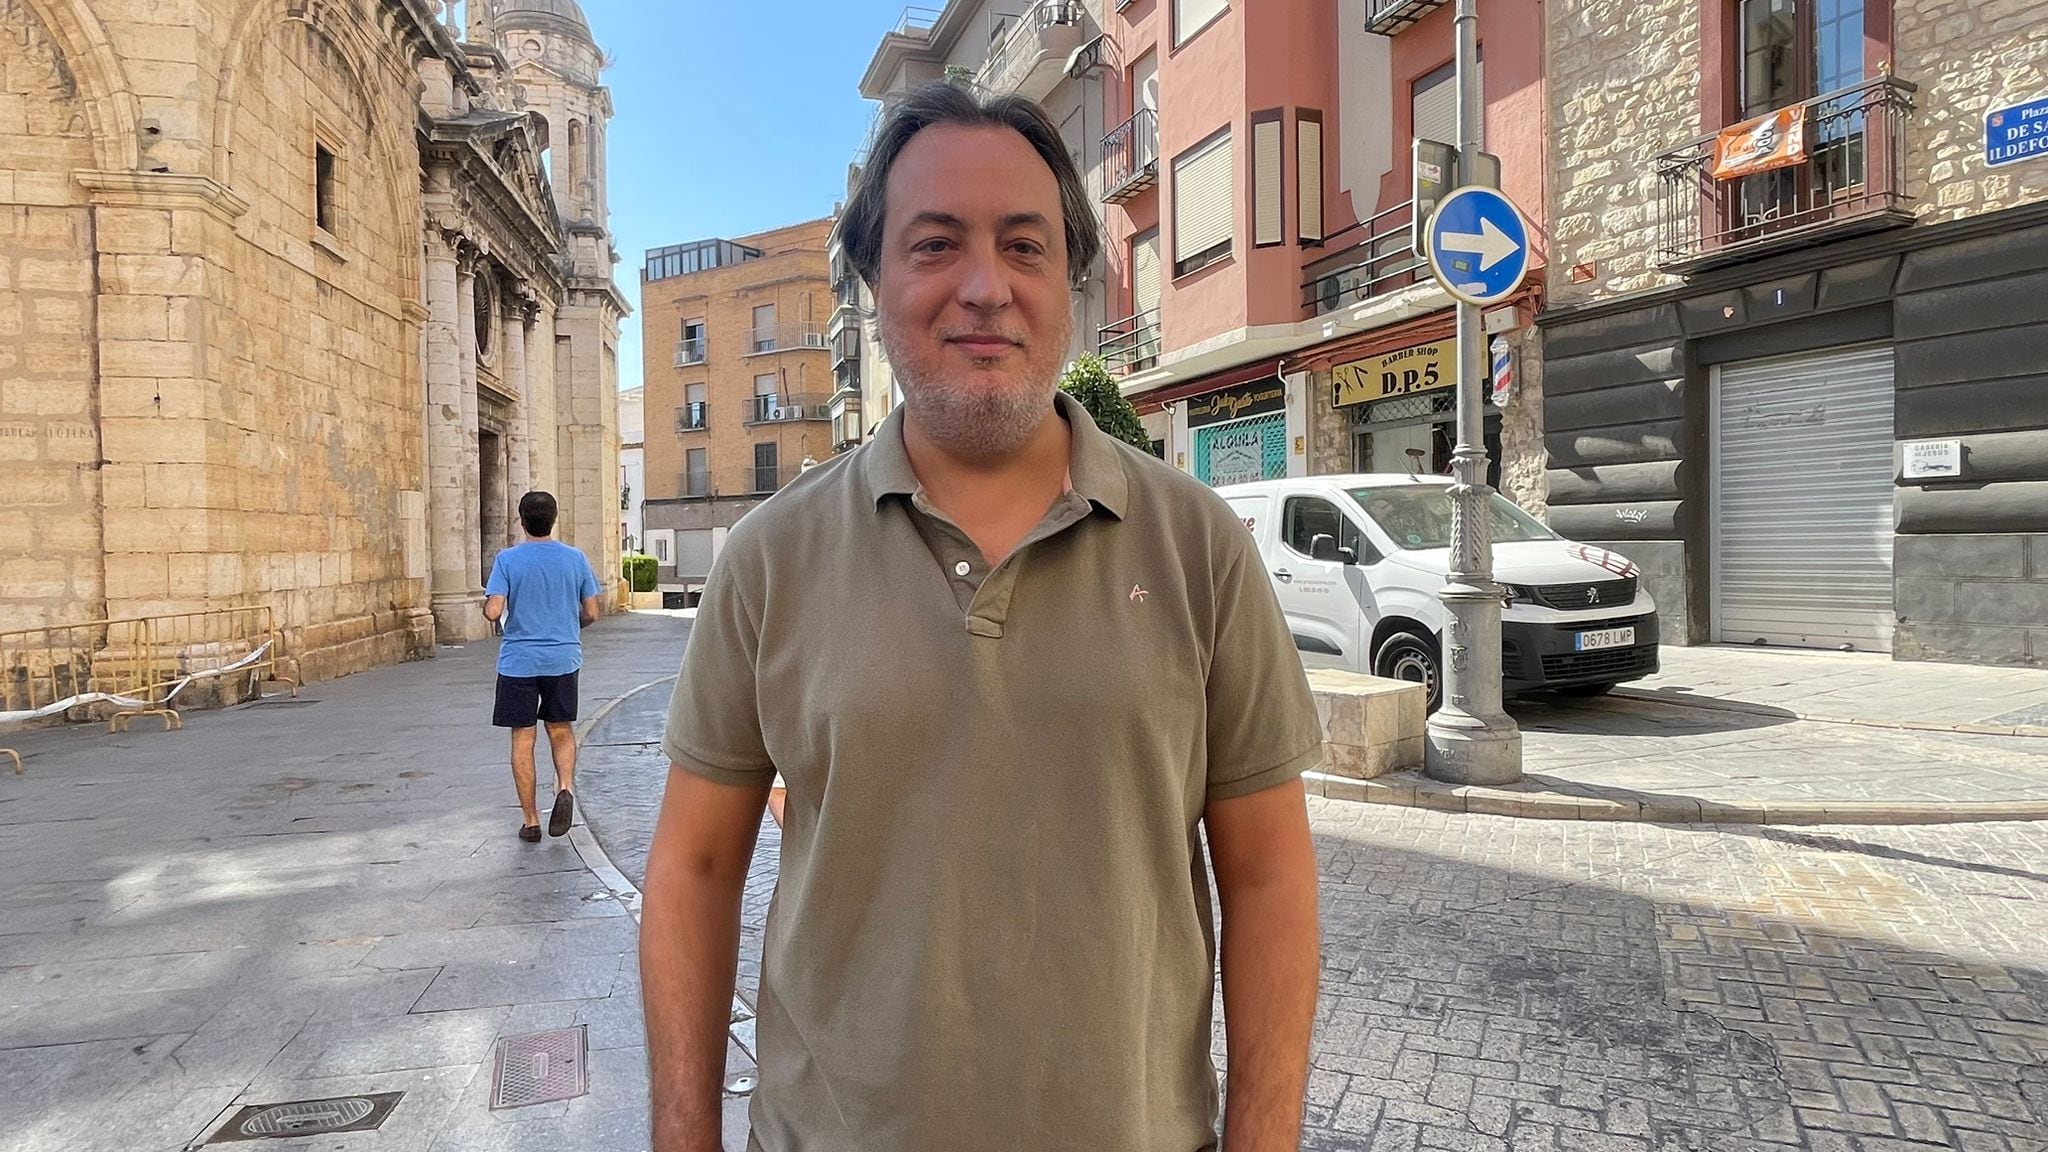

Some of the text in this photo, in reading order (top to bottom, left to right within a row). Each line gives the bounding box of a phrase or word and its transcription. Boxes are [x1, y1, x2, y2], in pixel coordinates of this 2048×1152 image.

[2021, 107, 2048, 120] Plaz
[2007, 124, 2030, 141] DE
[1382, 347, 1439, 368] BARBER SHOP
[1213, 431, 1259, 450] ALQUILA
[1583, 629, 1632, 647] 0678 LMP
